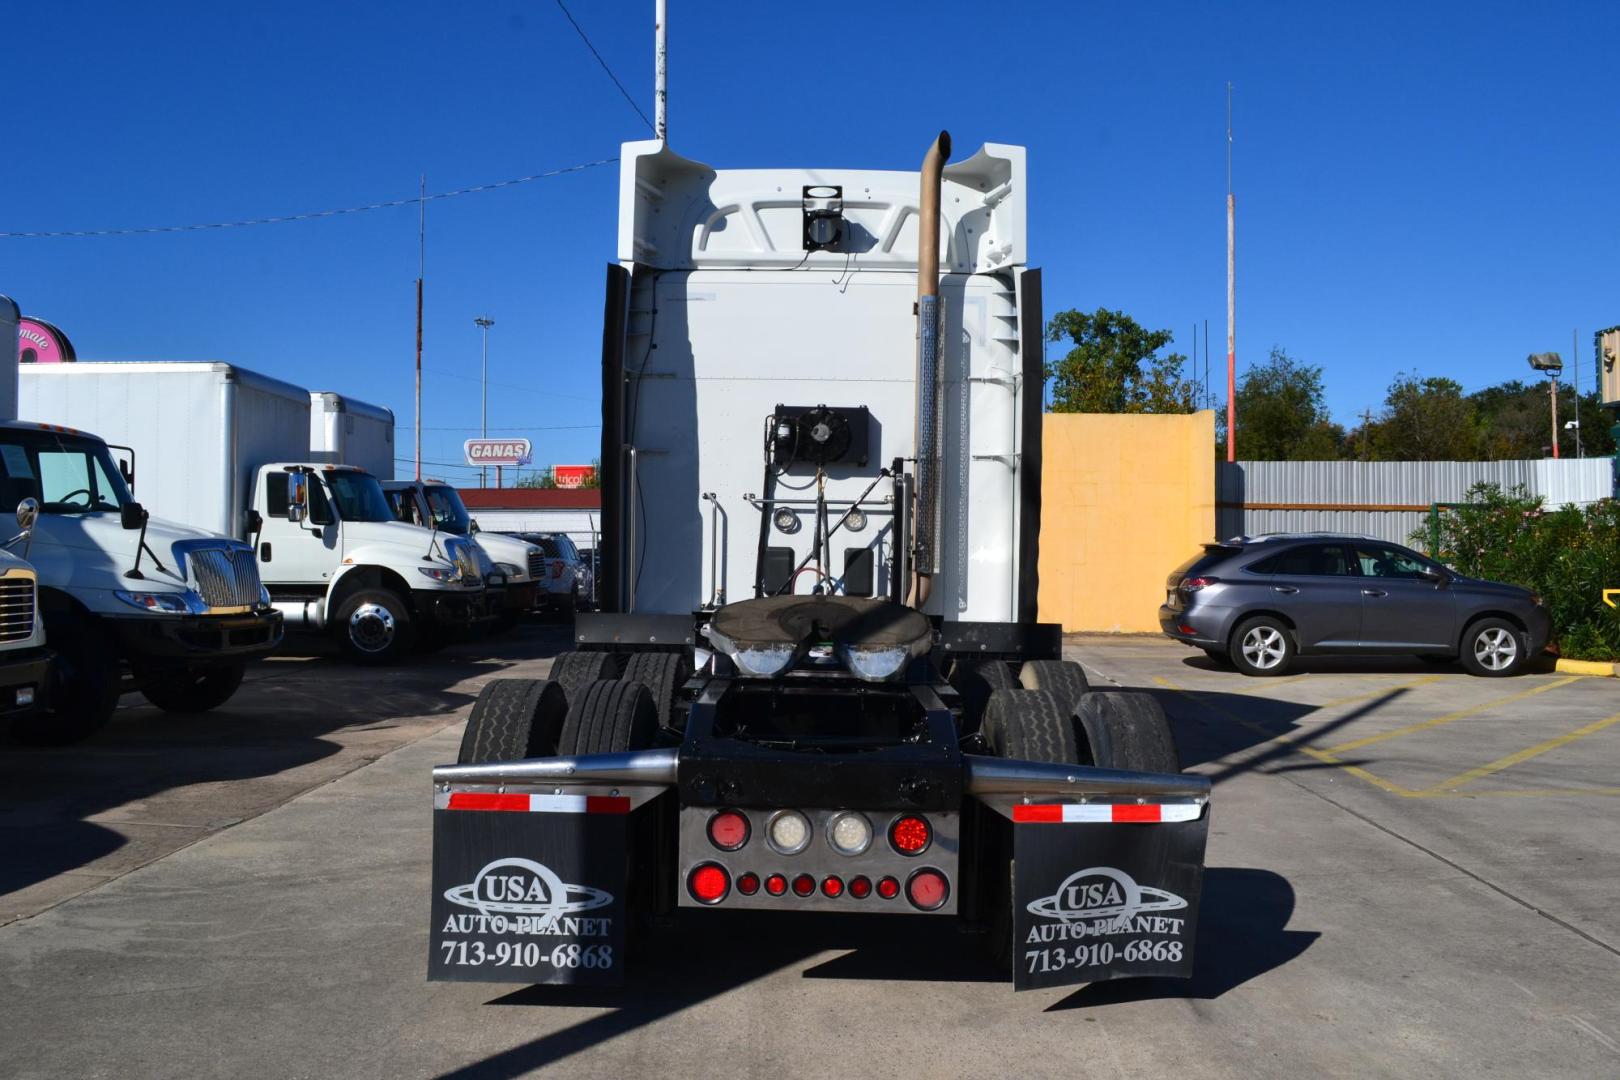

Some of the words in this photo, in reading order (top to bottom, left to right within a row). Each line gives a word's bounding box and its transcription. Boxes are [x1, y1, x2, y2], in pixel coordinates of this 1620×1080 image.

[471, 444, 524, 458] GANAS
[485, 875, 548, 902] USA
[1067, 881, 1123, 910] USA
[441, 941, 613, 969] 713-910-6868
[1025, 939, 1183, 974] 713-910-6868
